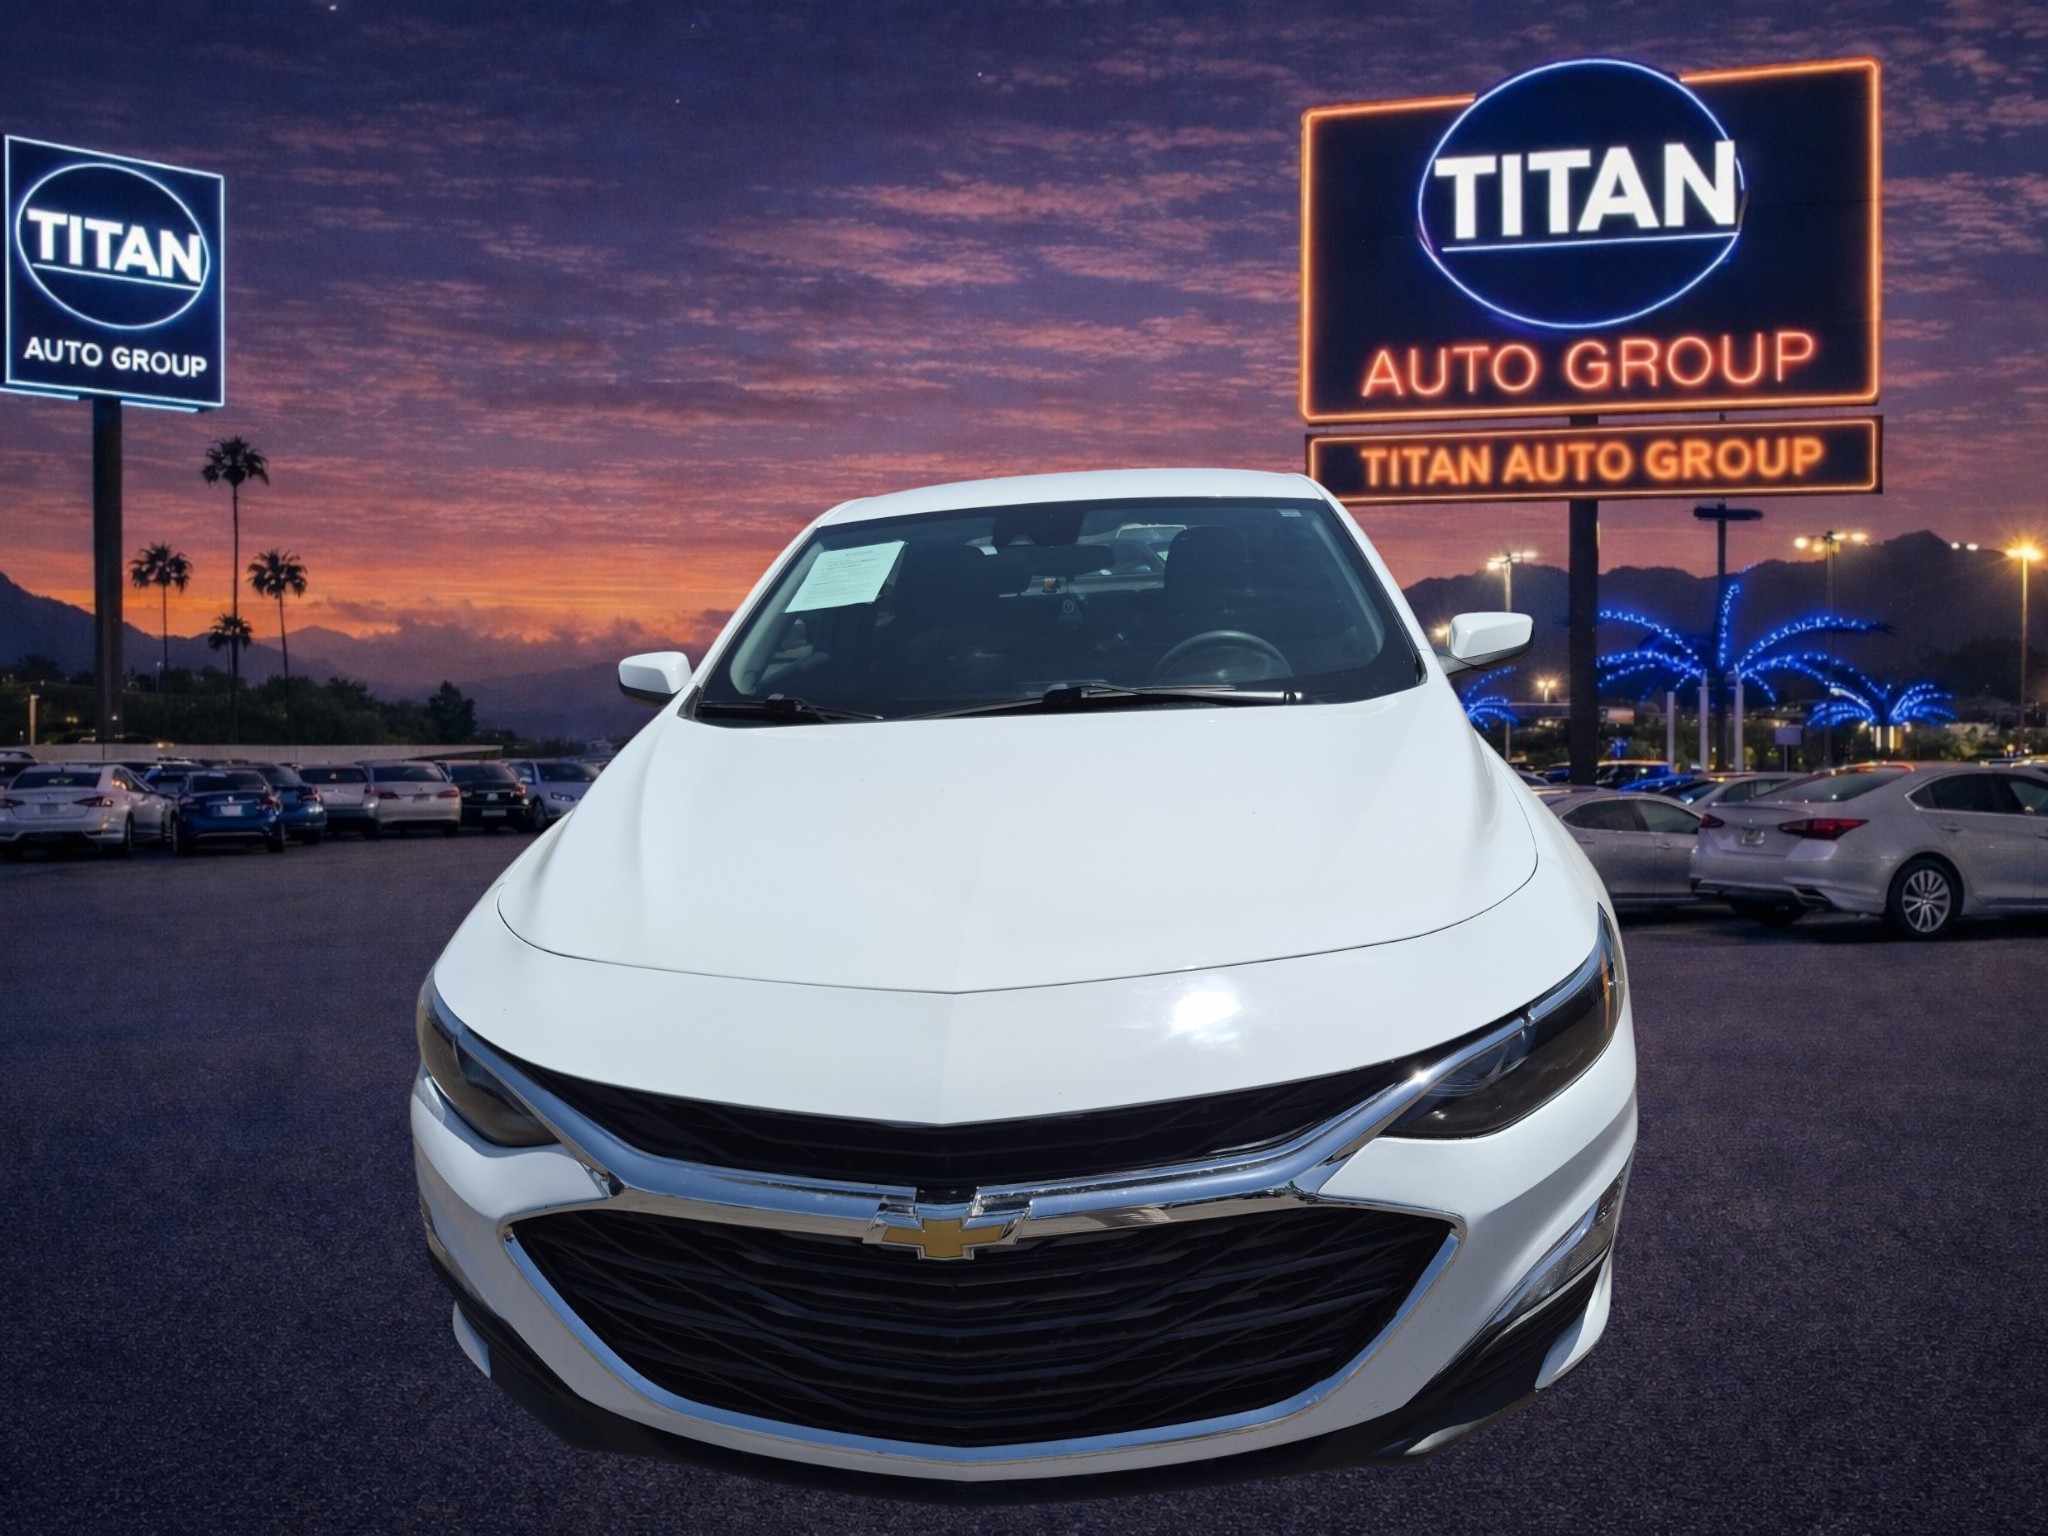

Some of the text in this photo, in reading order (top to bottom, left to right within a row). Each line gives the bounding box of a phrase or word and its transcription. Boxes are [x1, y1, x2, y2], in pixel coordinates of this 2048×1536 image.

[1434, 140, 1736, 240] TITAN
[26, 207, 202, 284] TITAN
[23, 336, 208, 378] AUTO GROUP
[1361, 331, 1816, 398] AUTO GROUP
[1360, 437, 1825, 487] TITAN AUTO GROUP
